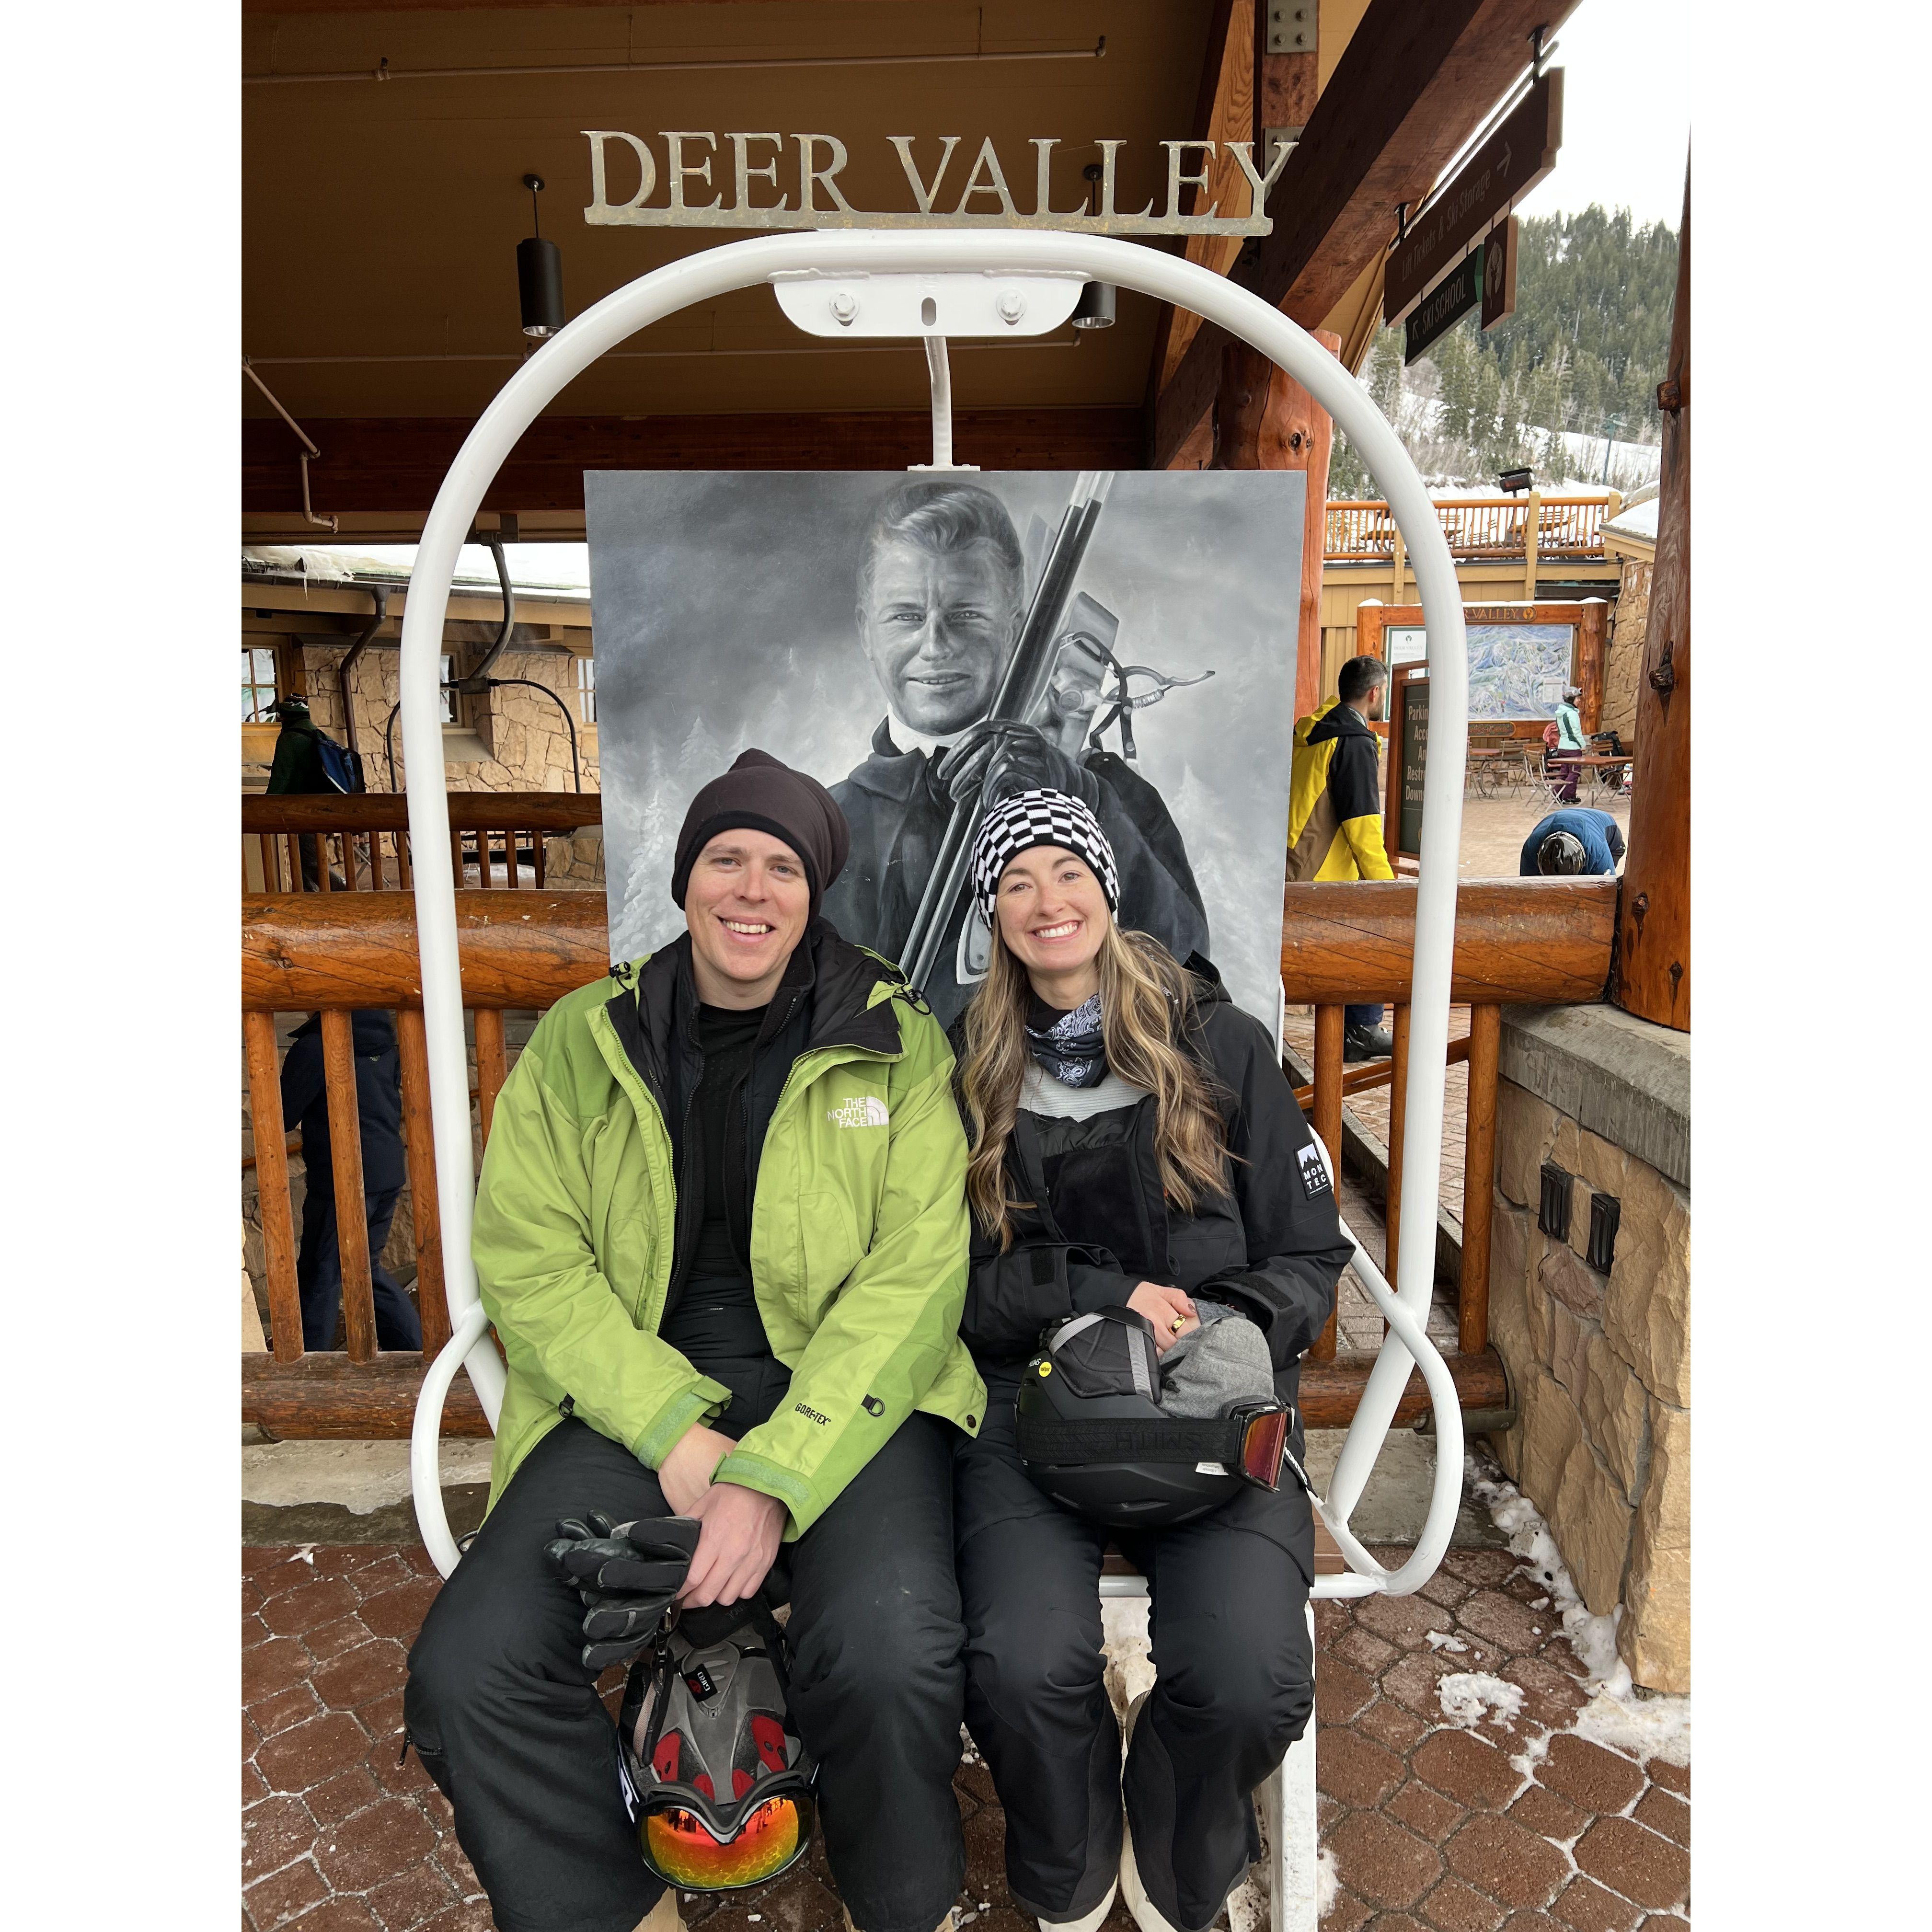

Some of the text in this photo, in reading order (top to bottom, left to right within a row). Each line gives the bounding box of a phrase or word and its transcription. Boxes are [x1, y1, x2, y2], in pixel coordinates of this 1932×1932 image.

[580, 131, 1299, 220] DEER VALLEY
[1402, 169, 1491, 282] Lift Tickets & Ski Storage
[1422, 274, 1466, 334] SKI SCHOOL
[1472, 609, 1518, 619] VALLEY
[1409, 705, 1428, 720] Parkin
[1414, 725, 1428, 740] Acce
[1418, 746, 1426, 761] An
[843, 1097, 866, 1108] THE
[827, 1107, 867, 1121] NORTH
[839, 1116, 868, 1128] FACE
[1303, 1164, 1323, 1180] MON
[1307, 1174, 1326, 1189] TEC
[697, 1671, 710, 1691] GIRO
